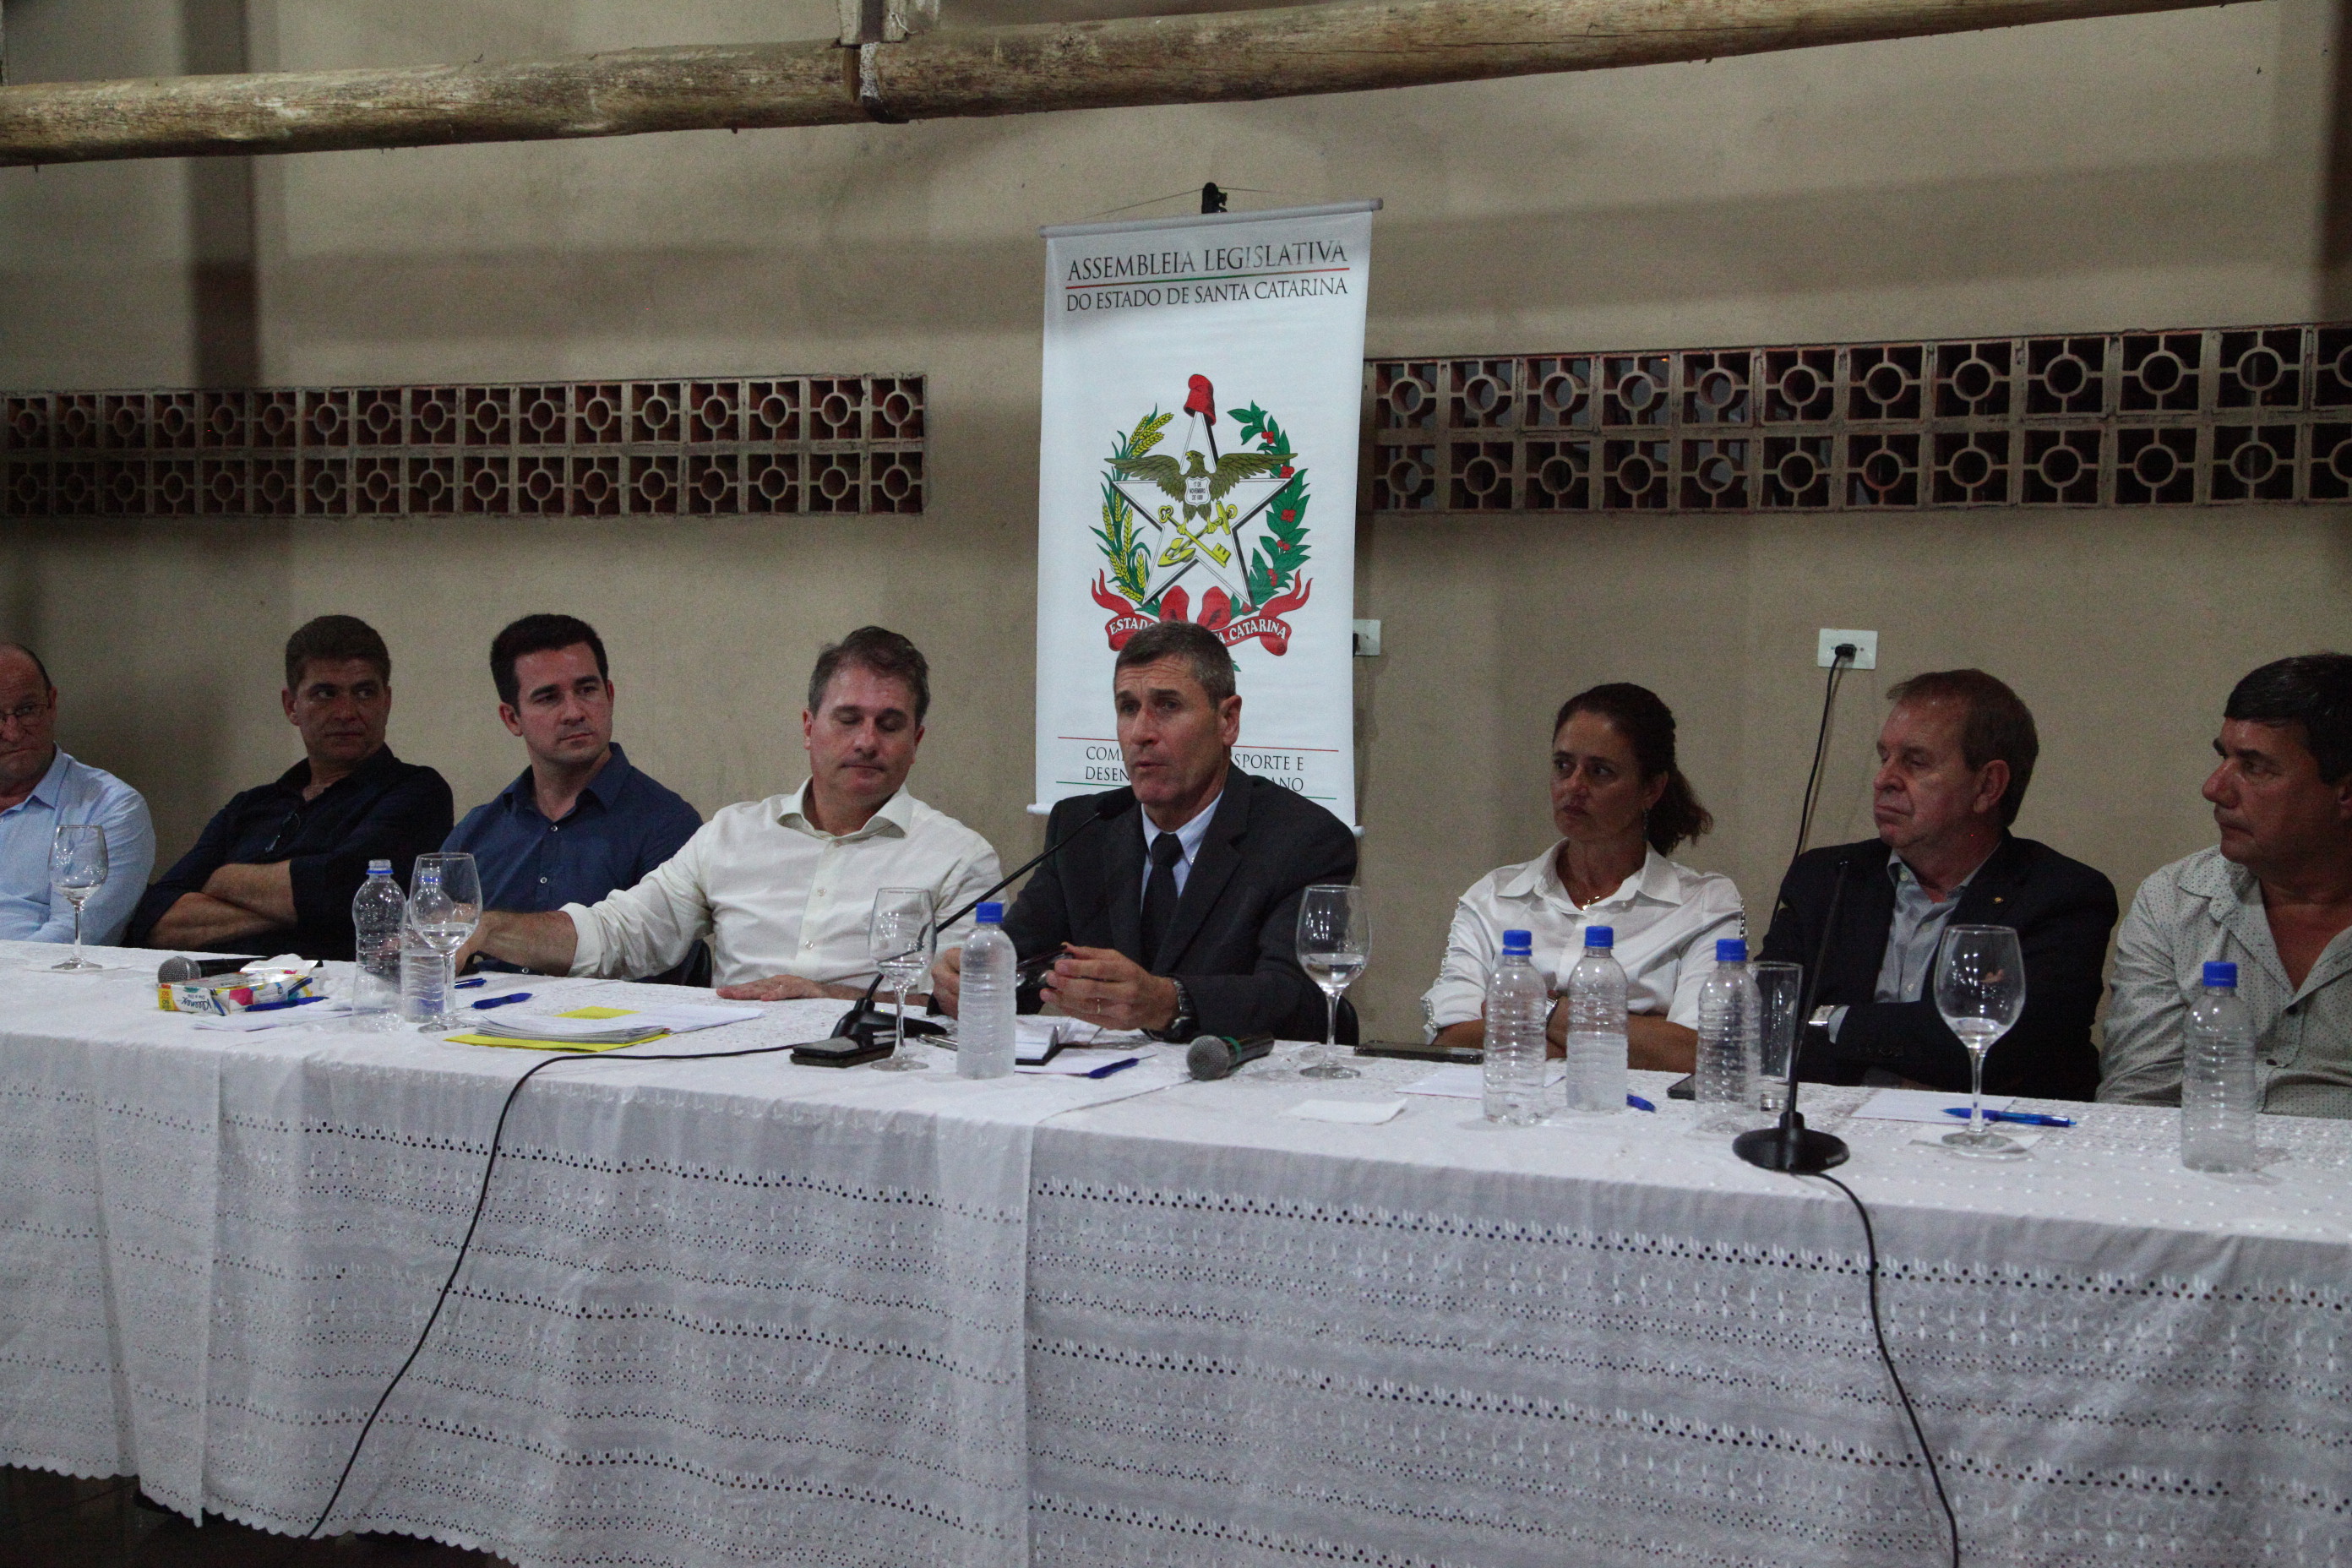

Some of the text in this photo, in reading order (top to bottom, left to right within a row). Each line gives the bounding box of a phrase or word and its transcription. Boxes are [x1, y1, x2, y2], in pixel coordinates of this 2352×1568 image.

[1067, 240, 1348, 280] ASSEMBLEIA LEGISLATIVA
[1066, 277, 1348, 312] DO ESTADO DE SANTA CATARINA
[1229, 618, 1287, 640] CATARINA
[1086, 746, 1304, 771] COM SPORTE E
[1085, 765, 1130, 781] DESEN
[181, 996, 212, 1011] Kleenex
